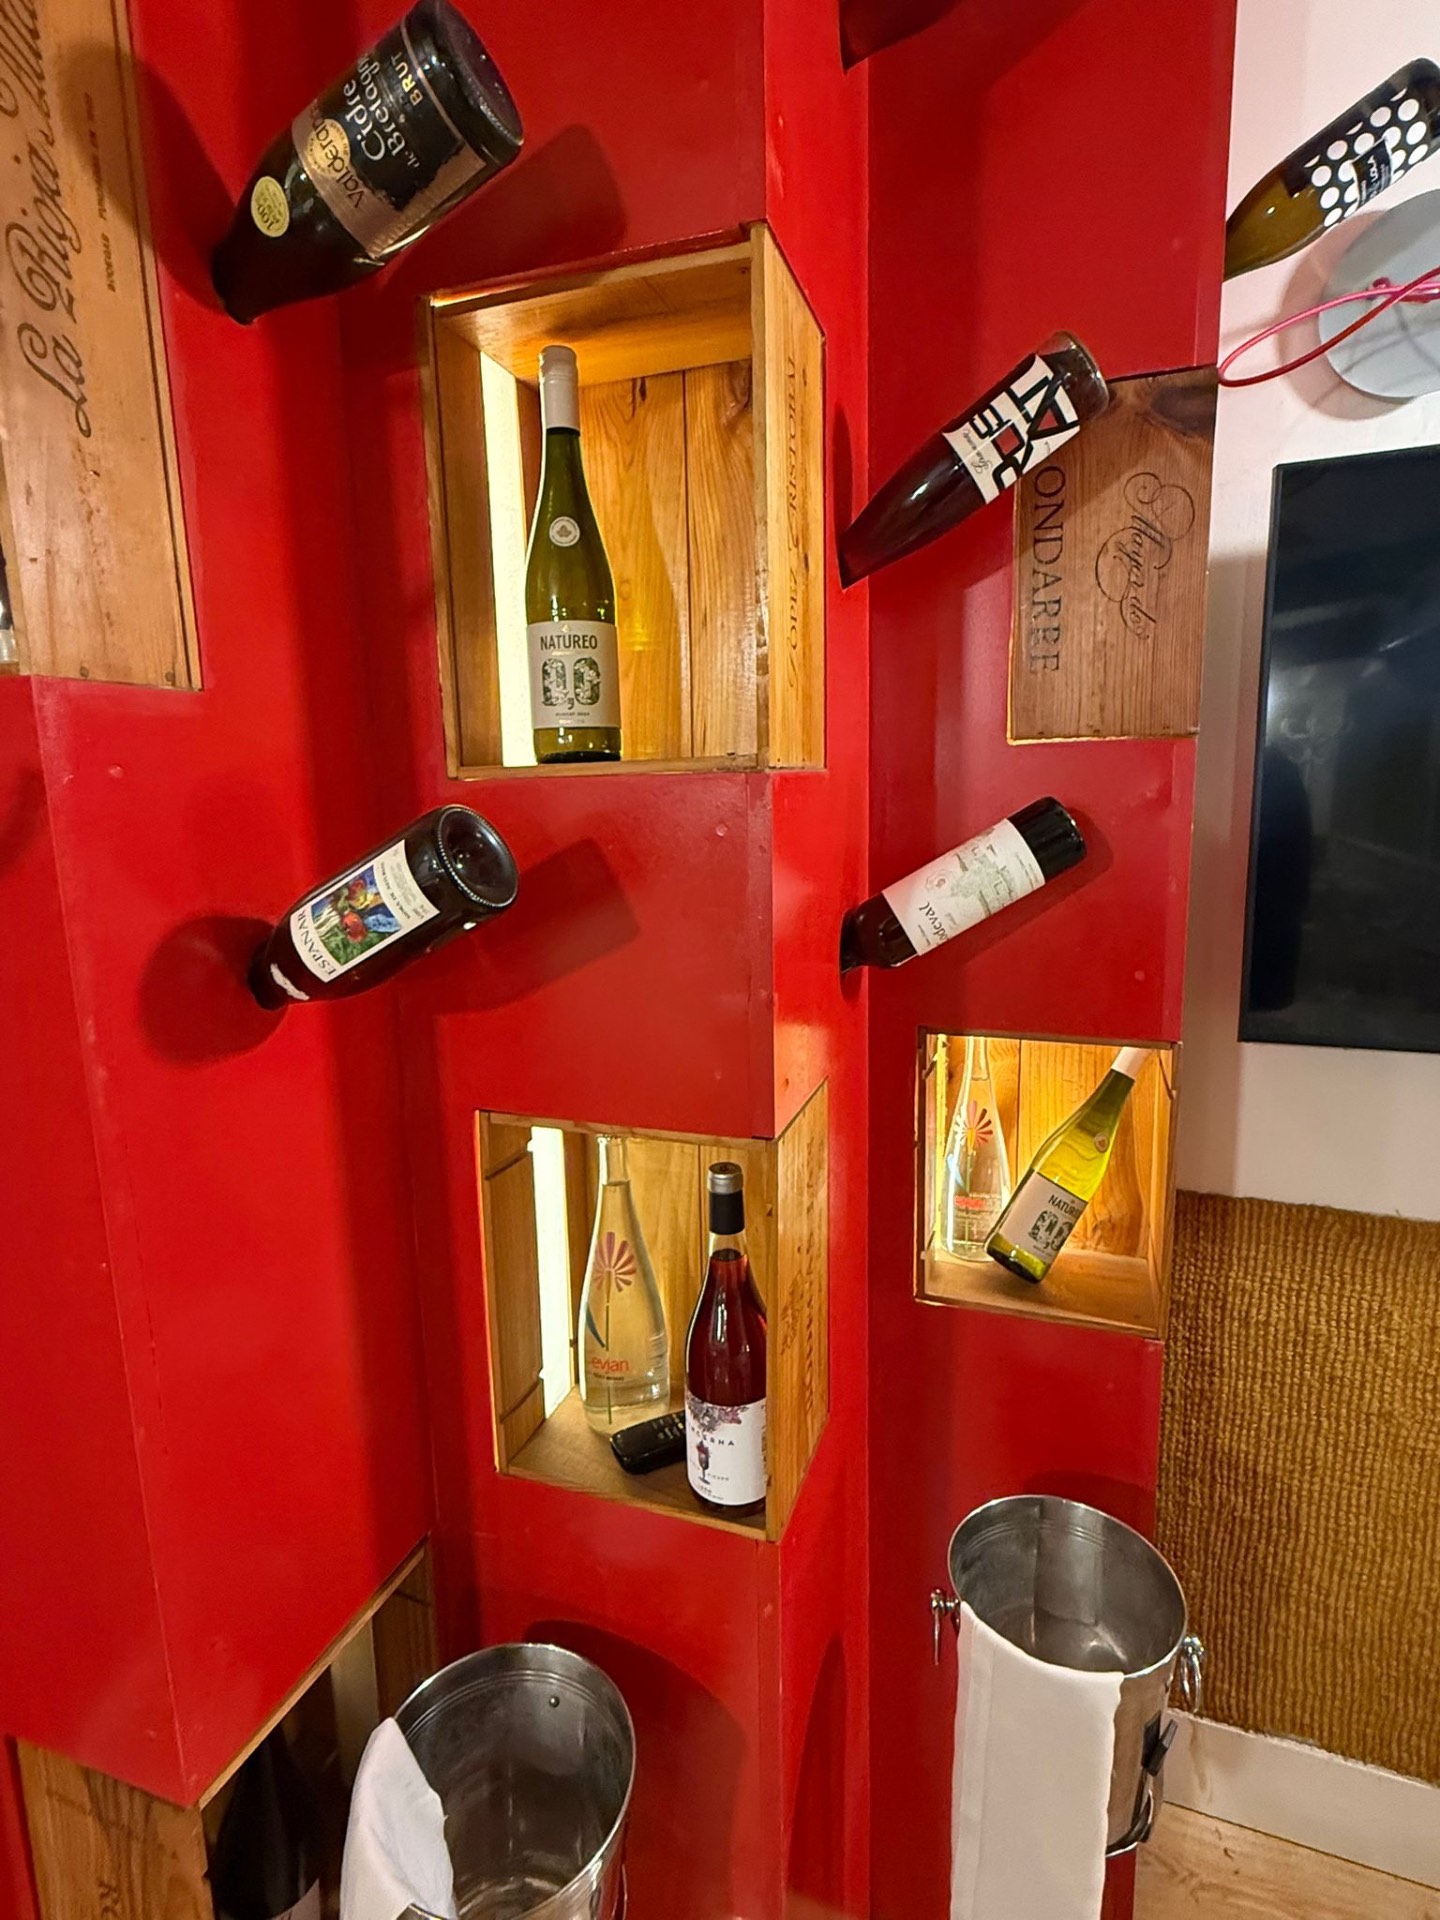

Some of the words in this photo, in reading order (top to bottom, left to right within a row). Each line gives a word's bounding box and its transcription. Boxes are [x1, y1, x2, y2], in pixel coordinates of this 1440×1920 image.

[390, 51, 424, 107] BRUT
[343, 79, 386, 162] Cidre
[1367, 154, 1379, 183] LOLA
[5, 137, 83, 324] Rioja
[16, 321, 92, 439] La
[540, 634, 599, 651] NATUREO
[591, 1355, 630, 1374] evian
